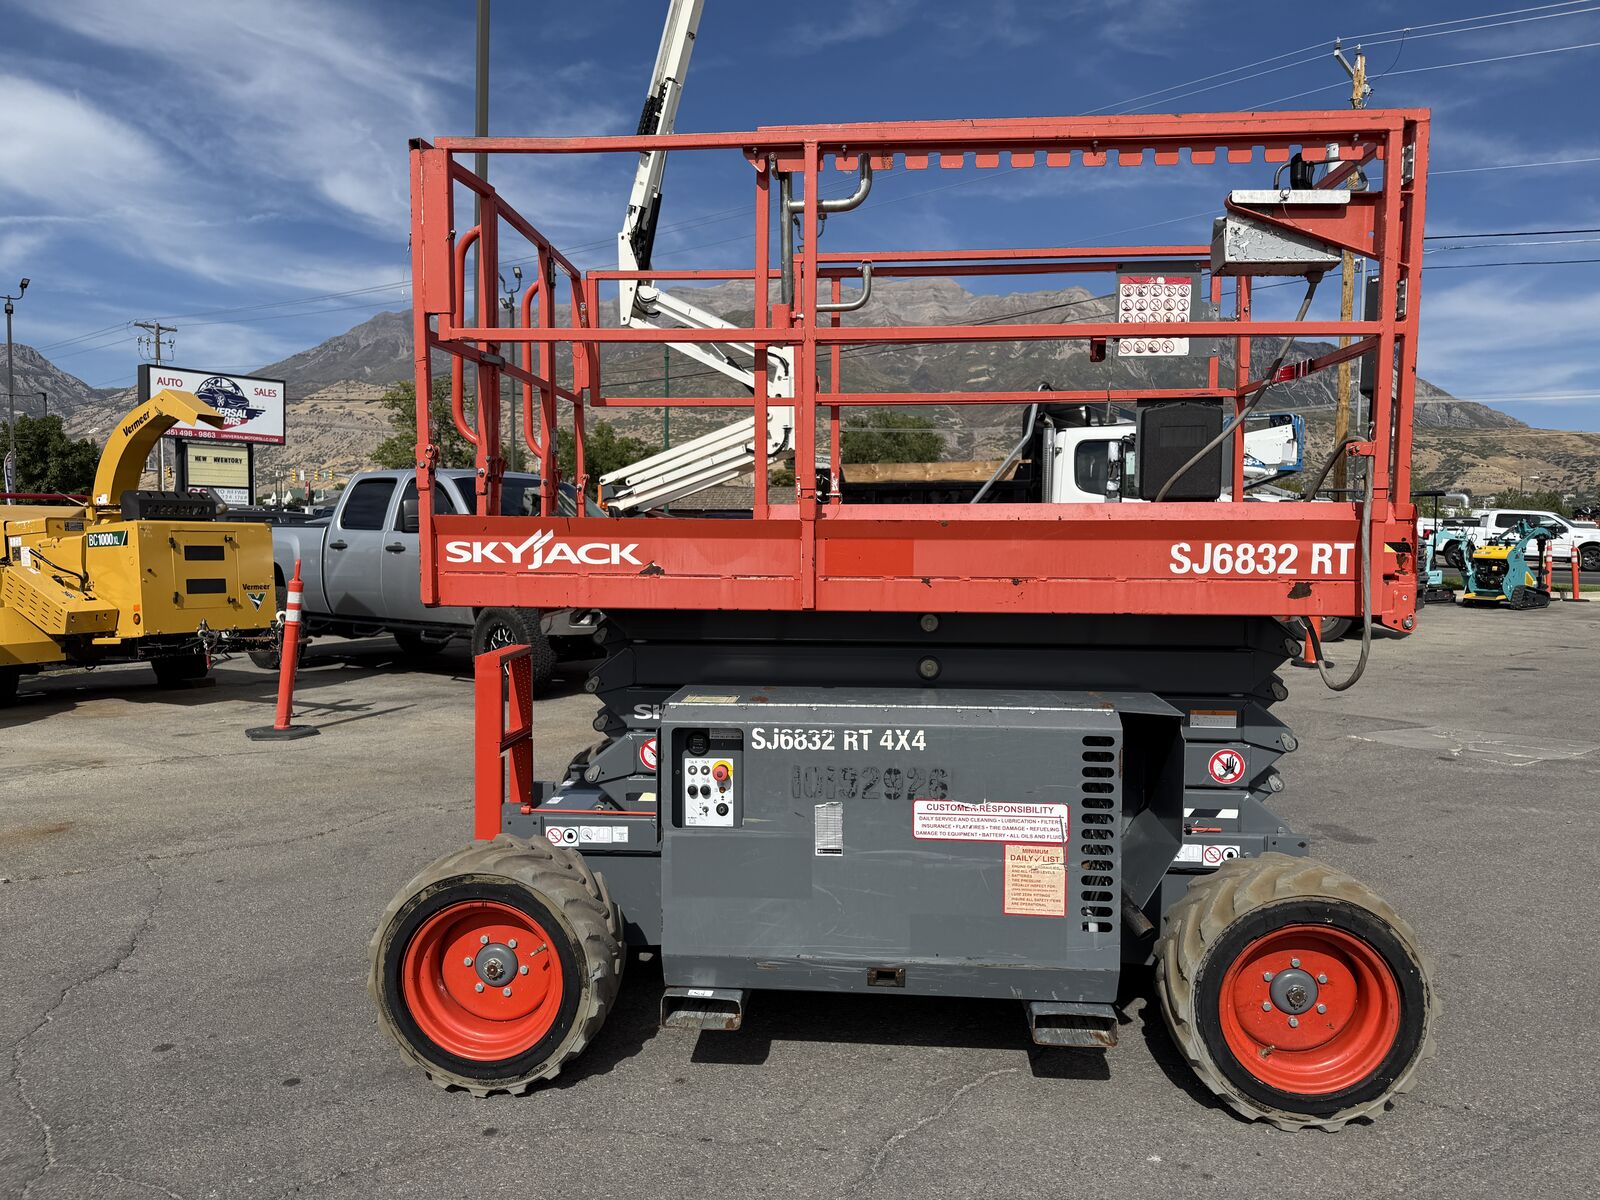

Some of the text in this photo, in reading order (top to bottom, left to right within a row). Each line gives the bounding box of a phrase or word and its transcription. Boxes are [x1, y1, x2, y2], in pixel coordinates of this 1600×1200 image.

[156, 377, 183, 388] AUTO
[254, 388, 277, 397] SALES
[122, 410, 150, 437] Vermeer
[223, 416, 241, 426] ORS
[180, 429, 193, 437] 498
[445, 529, 643, 570] SKYJACK
[1169, 542, 1355, 575] SJ6832 RT
[751, 727, 835, 750] SJ6832
[844, 729, 872, 751] RT
[879, 729, 926, 751] 4X4
[926, 803, 1054, 814] CUSTOMER RESPONSIBILITY
[1010, 854, 1060, 863] DAILY LIST
